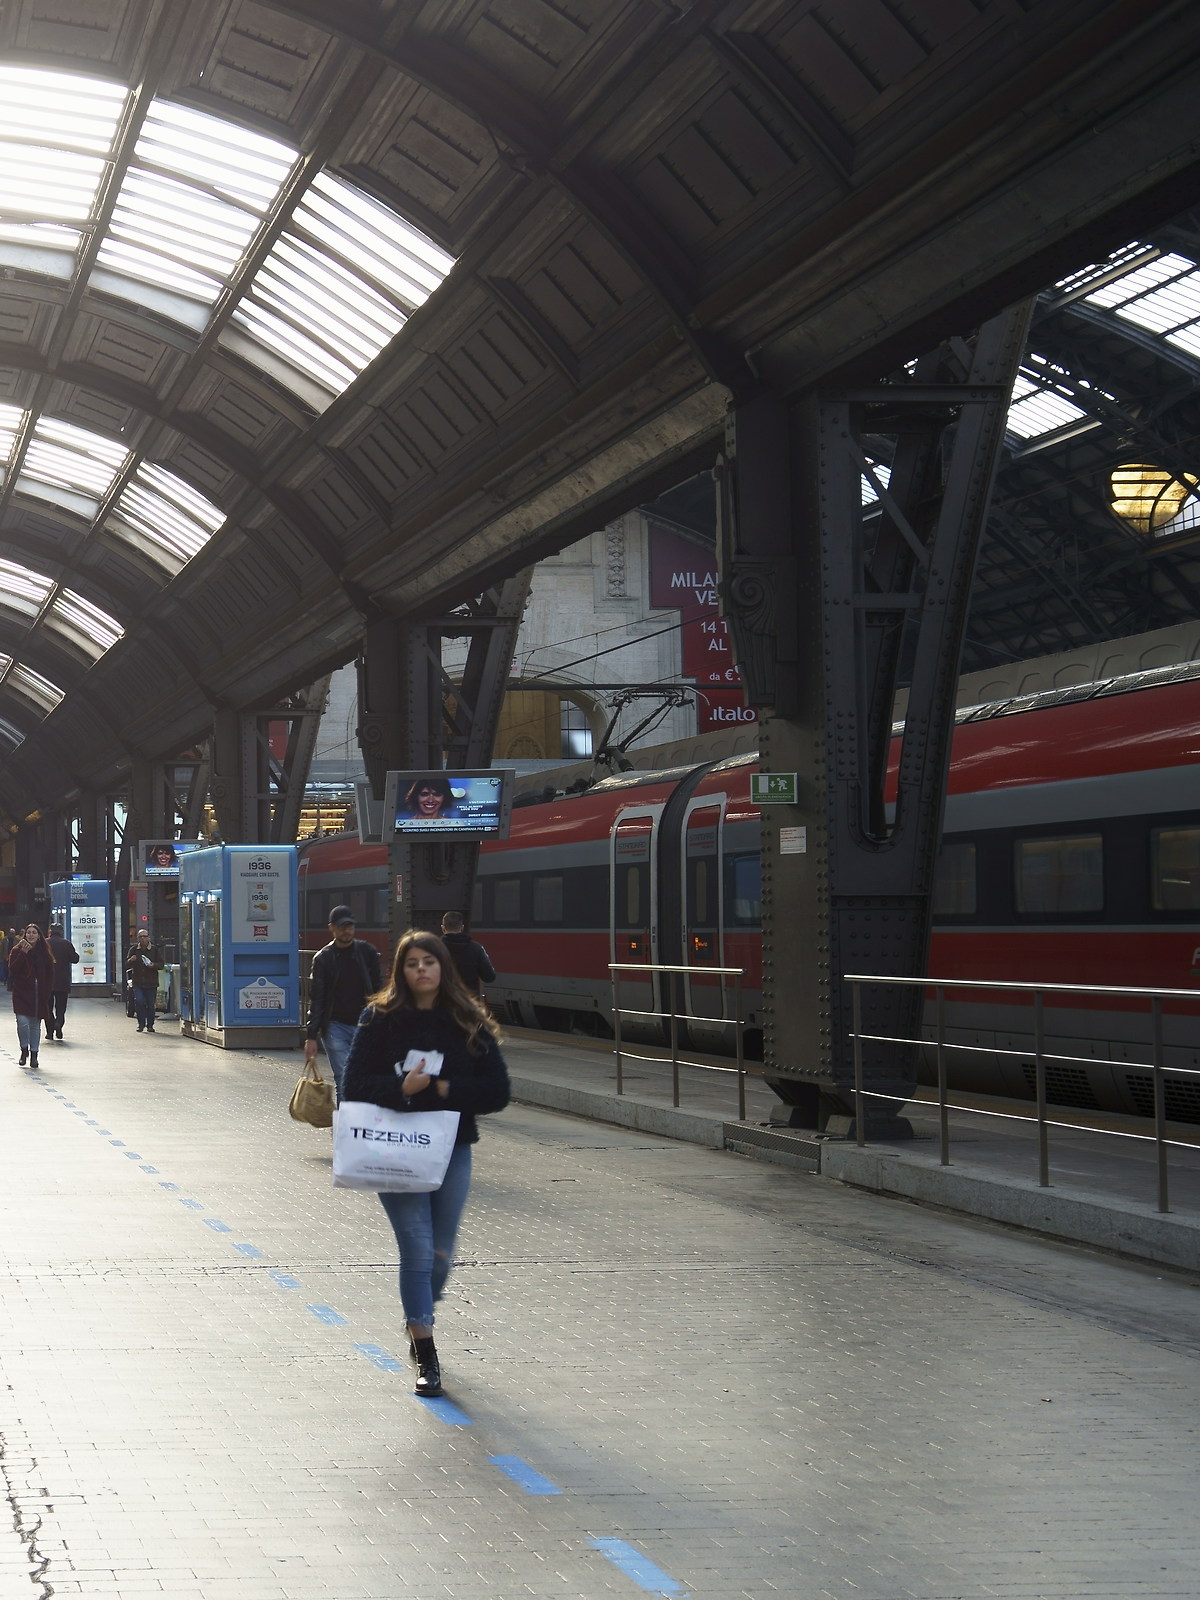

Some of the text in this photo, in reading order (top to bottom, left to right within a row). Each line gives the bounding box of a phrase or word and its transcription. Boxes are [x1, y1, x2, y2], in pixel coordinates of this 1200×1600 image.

[701, 621, 717, 633] 14
[708, 638, 728, 651] AL
[709, 672, 720, 681] da
[248, 862, 272, 870] 1936
